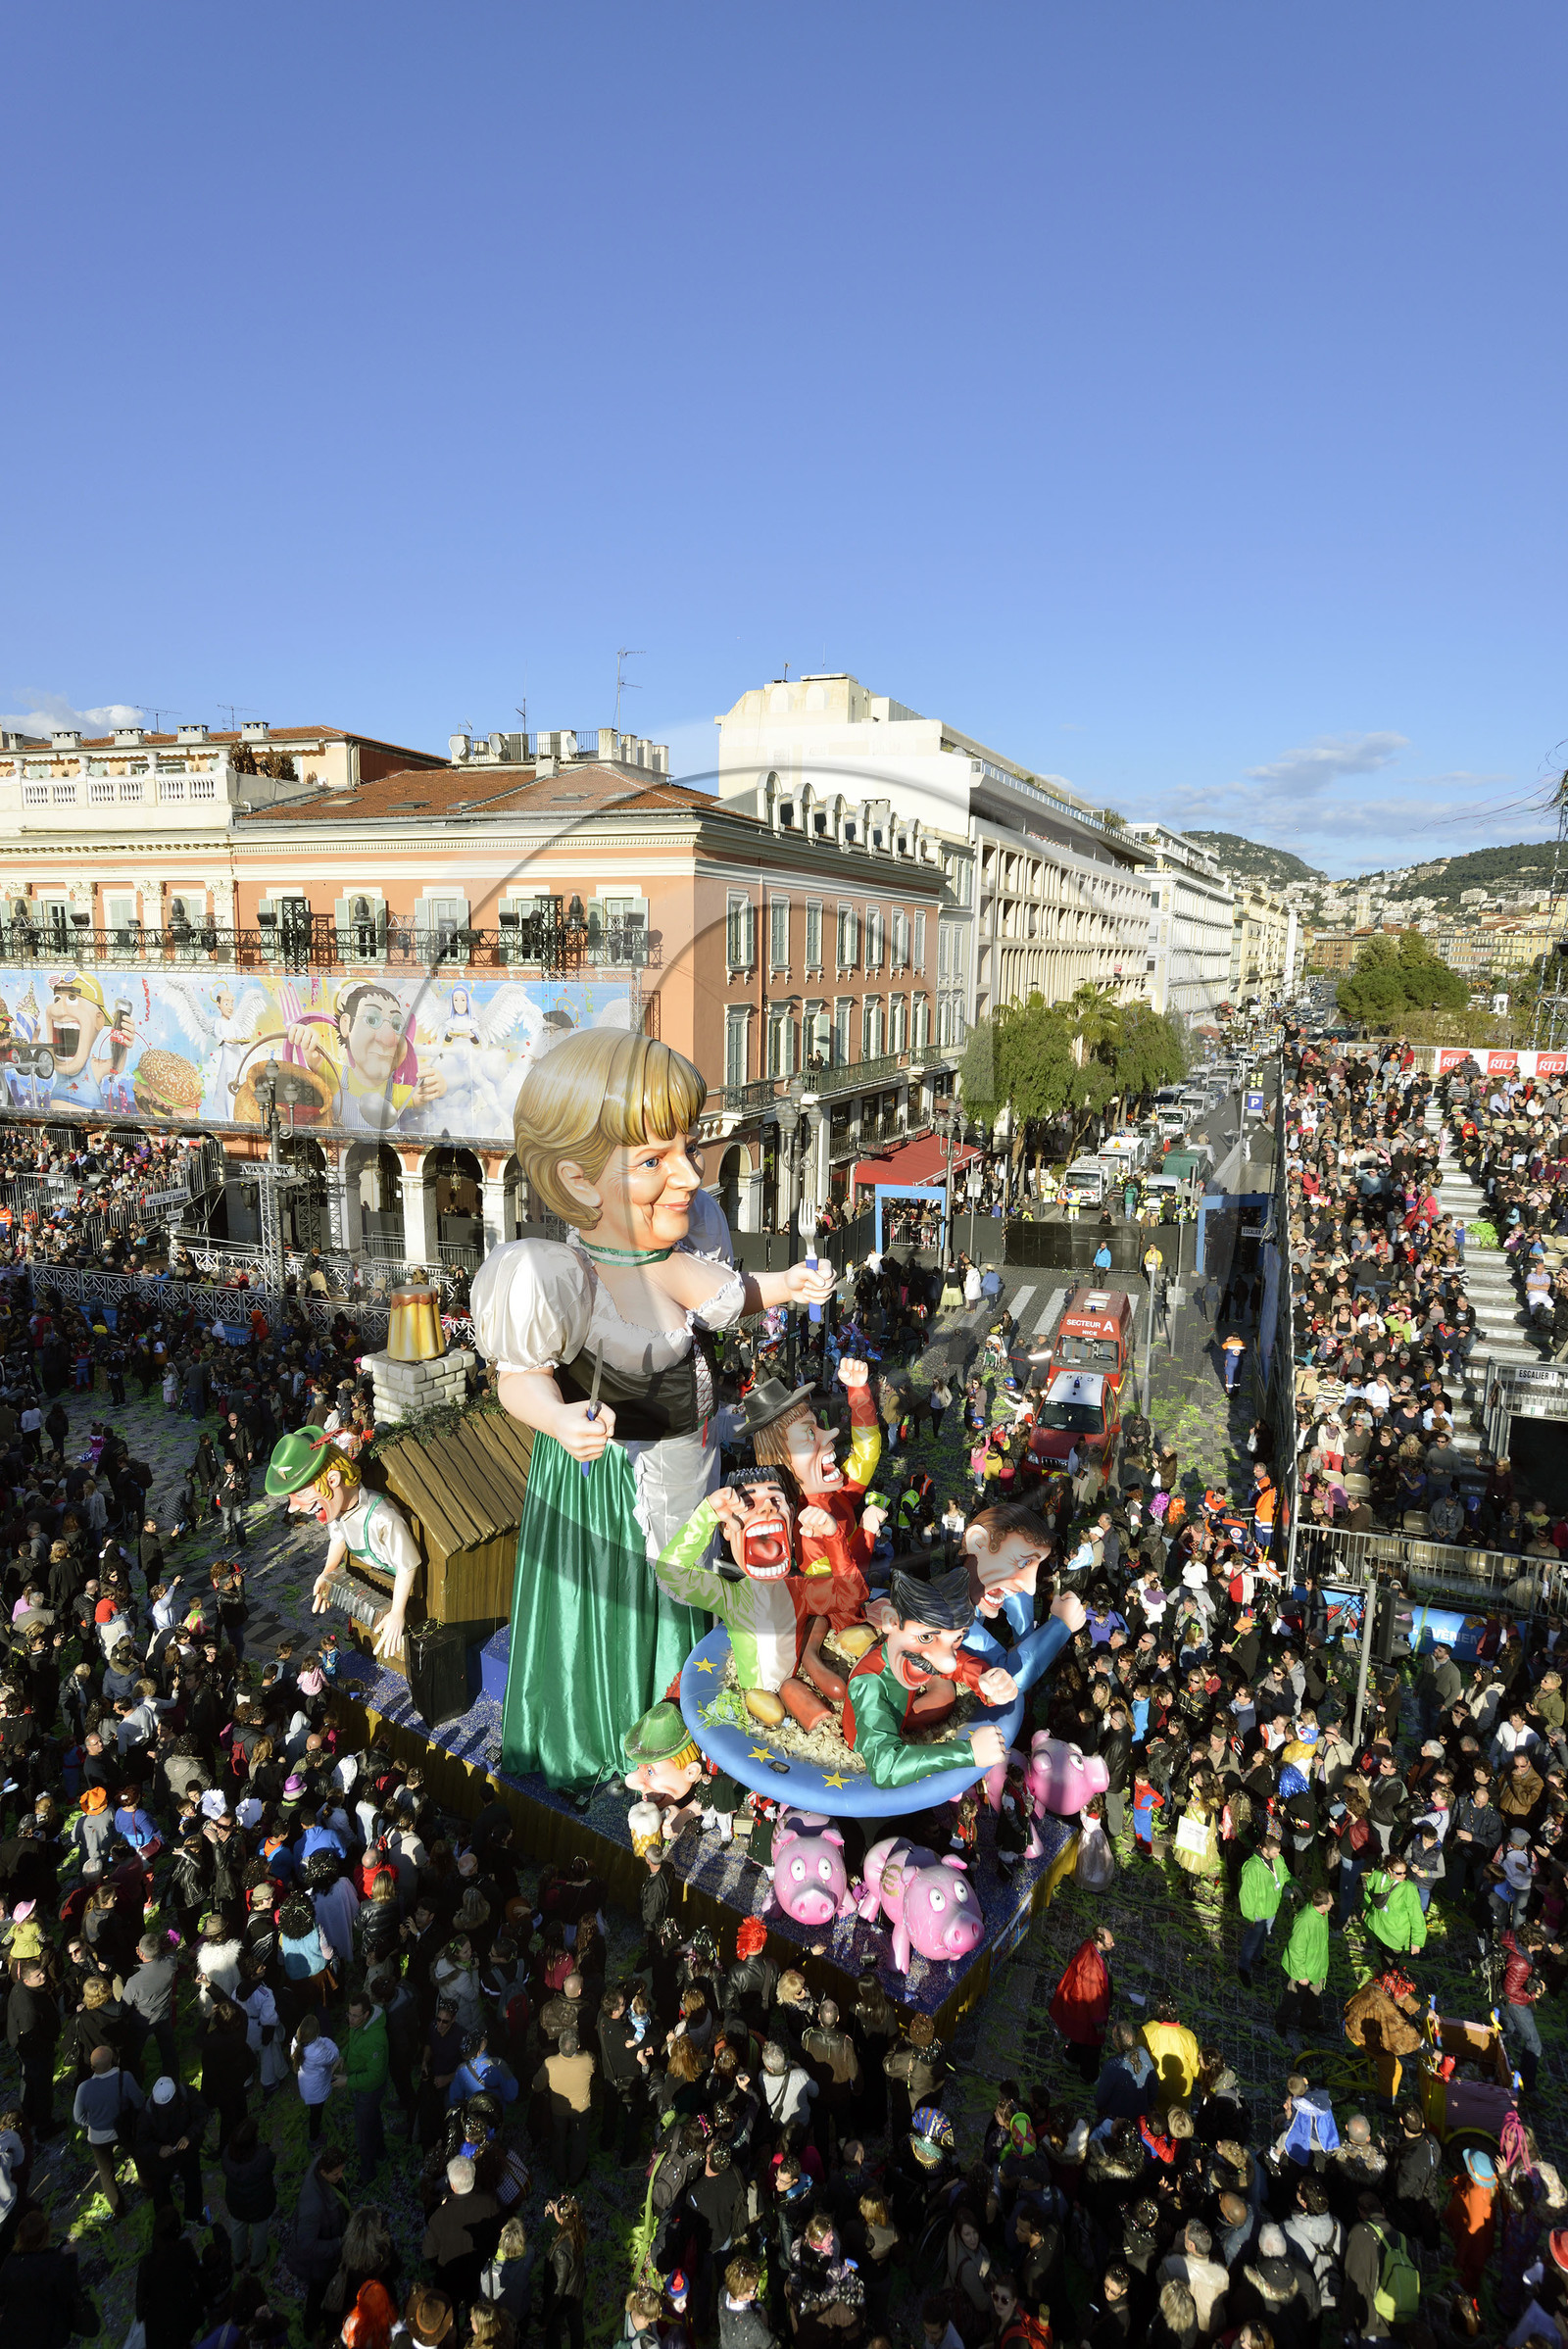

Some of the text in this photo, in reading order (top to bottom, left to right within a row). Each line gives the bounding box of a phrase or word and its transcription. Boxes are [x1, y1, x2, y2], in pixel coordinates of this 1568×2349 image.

[1490, 1058, 1515, 1070] RTL2
[1538, 1060, 1565, 1072] RTL2
[1250, 1098, 1259, 1107] P
[149, 1192, 188, 1205] FELIX FAURE
[1066, 1319, 1114, 1333] SECTEUR A
[1518, 1369, 1549, 1380] ESCALIER
